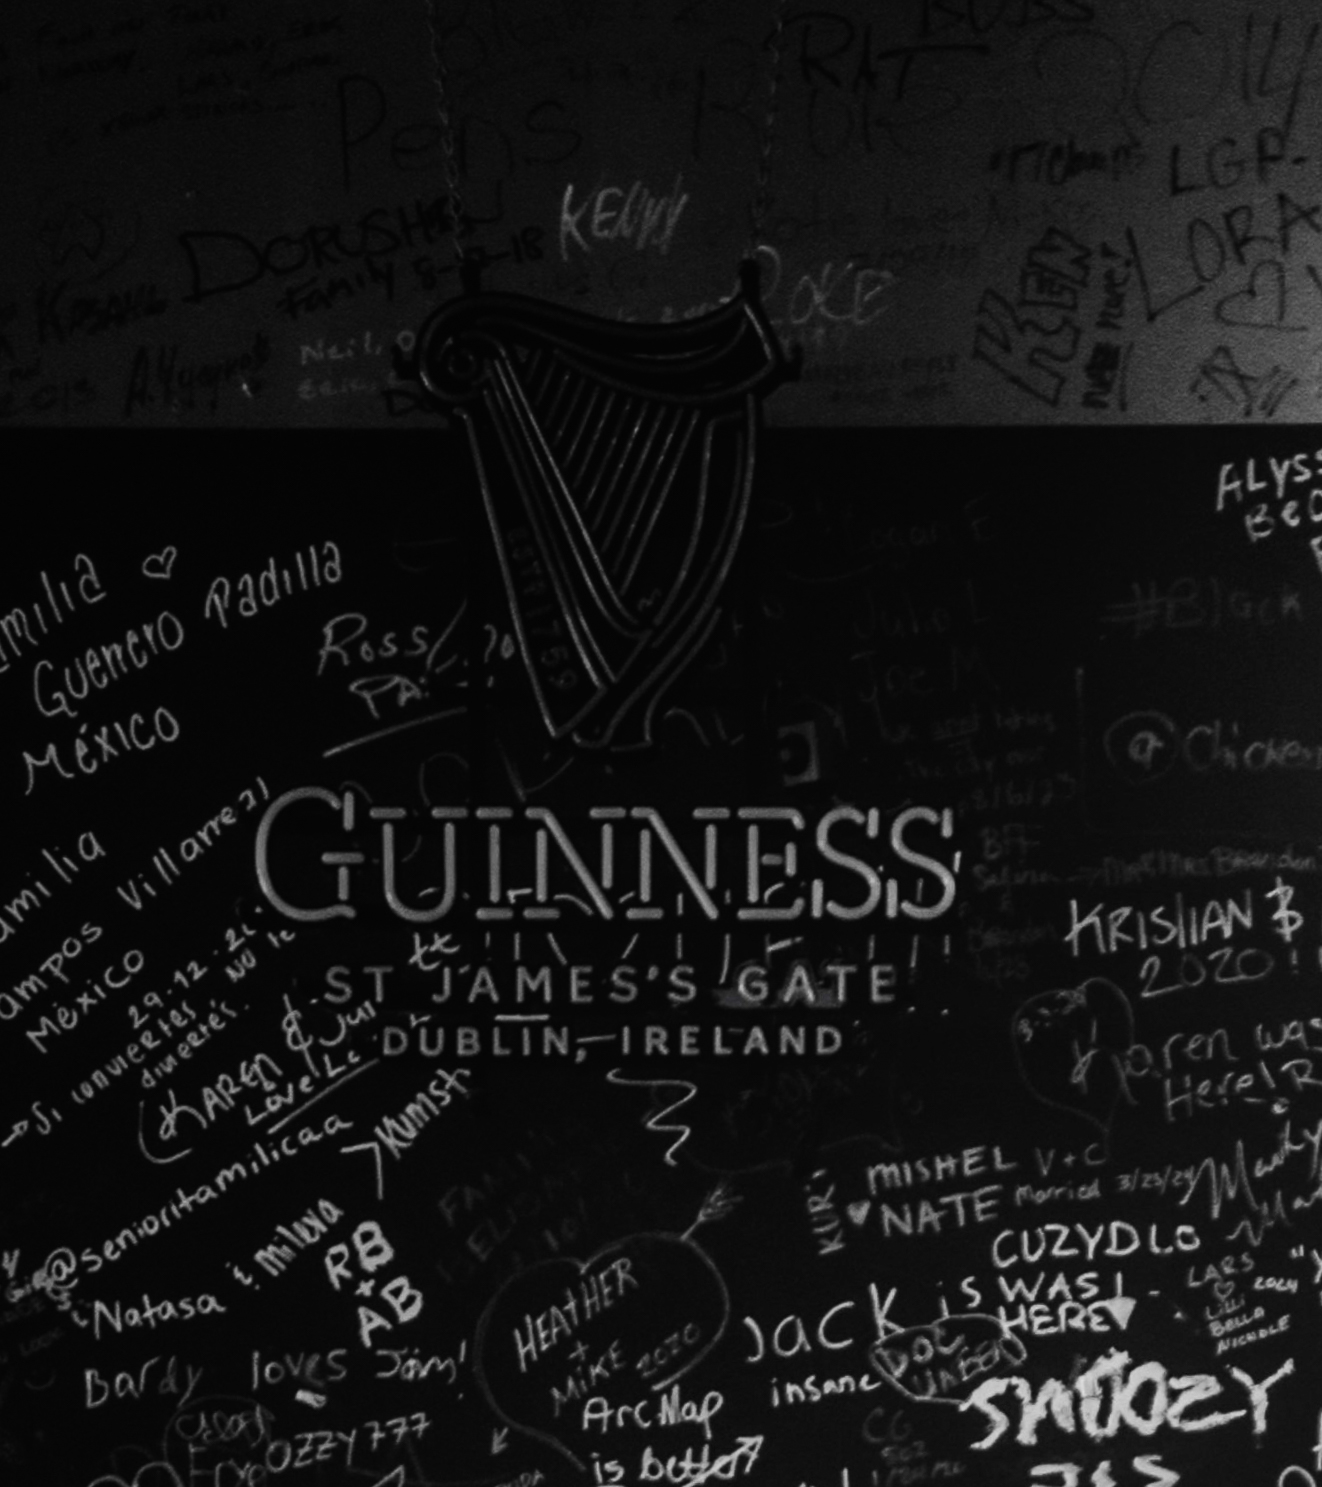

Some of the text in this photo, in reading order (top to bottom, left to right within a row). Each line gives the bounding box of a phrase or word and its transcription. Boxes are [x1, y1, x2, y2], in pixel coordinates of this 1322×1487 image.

[205, 540, 342, 629] Padilla
[256, 785, 960, 922] GUINNESS
[324, 966, 393, 1004] ST
[738, 962, 898, 1004] GATE
[621, 1026, 843, 1057] IRELAND
[878, 1190, 1001, 1237] NATE
[991, 1222, 1201, 1268] CUZYDLO
[998, 1275, 1099, 1301] WAS
[92, 1291, 227, 1339] Natasa
[252, 1349, 349, 1390] loves
[769, 1373, 882, 1408] insane
[591, 1452, 625, 1483] is
